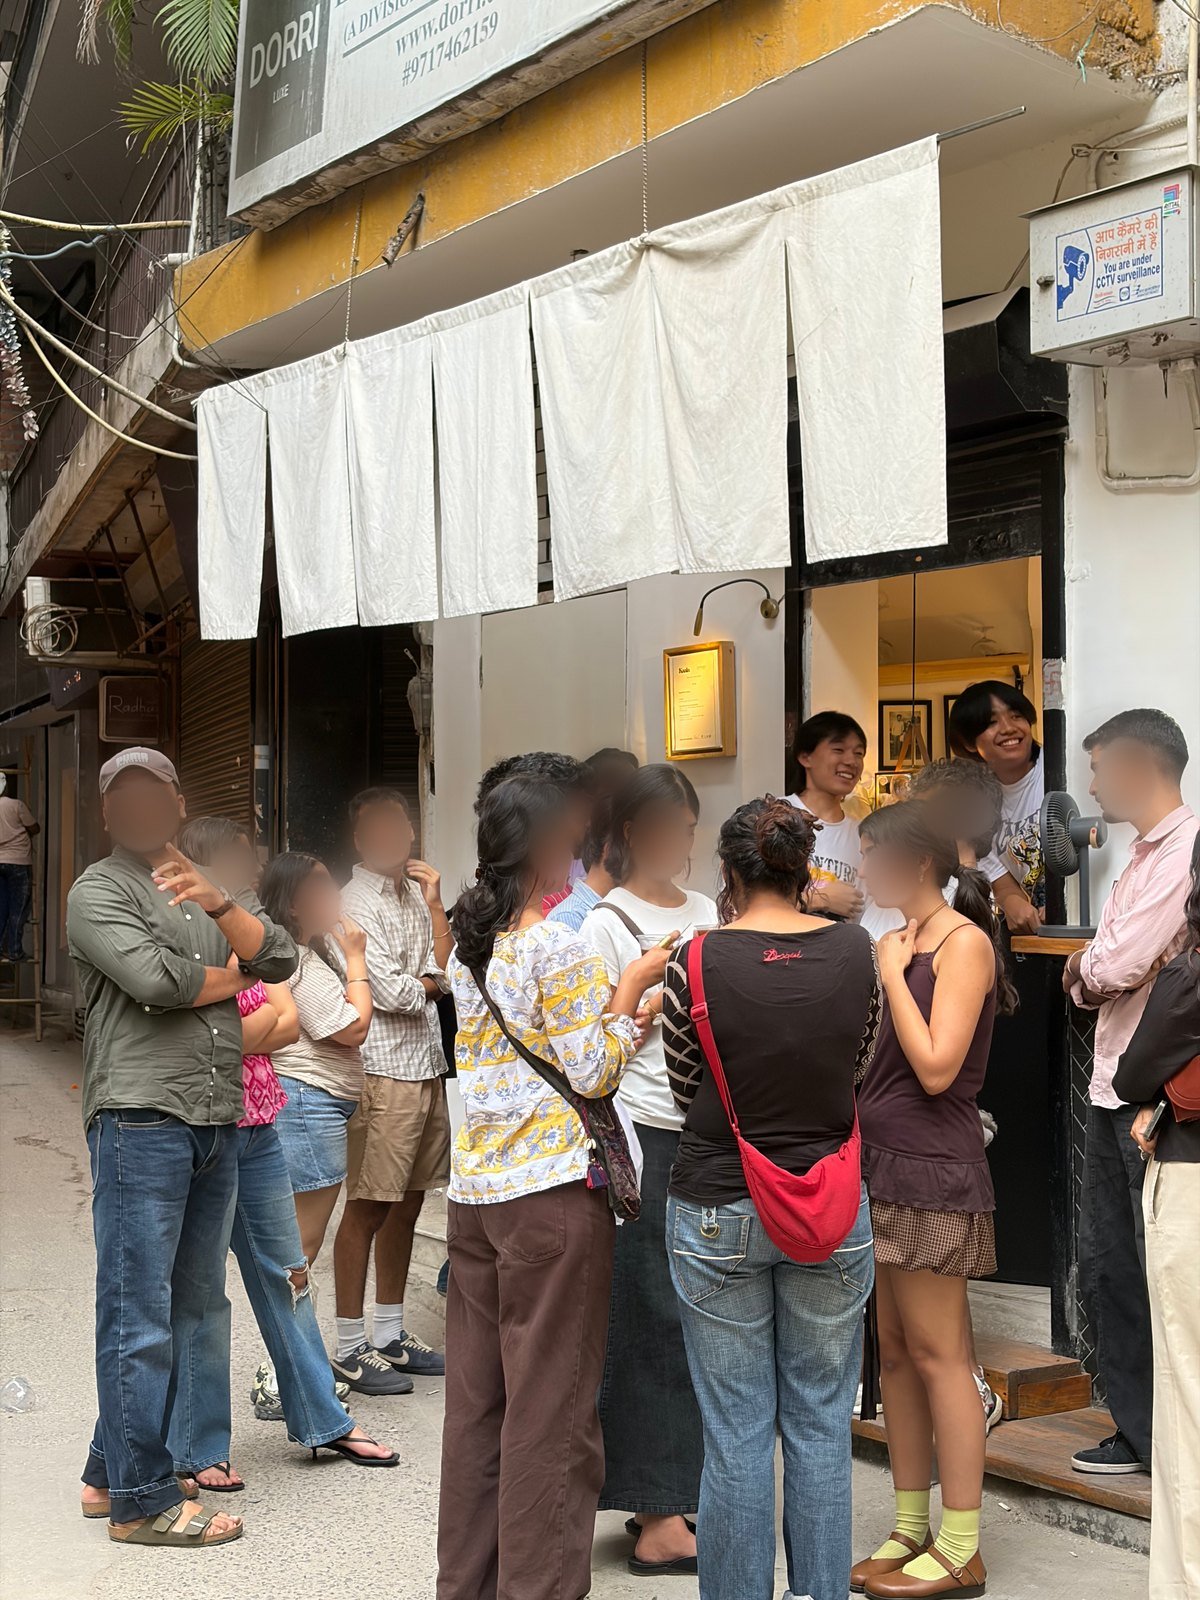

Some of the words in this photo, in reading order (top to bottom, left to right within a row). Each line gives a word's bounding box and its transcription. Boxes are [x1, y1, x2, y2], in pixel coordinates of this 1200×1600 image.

[343, 21, 356, 46] (A
[360, 0, 413, 33] DIVISI
[250, 4, 320, 88] DORRI
[402, 11, 498, 87] #9717462159
[1095, 228, 1115, 244] आप
[1117, 217, 1141, 238] कैमरे
[1145, 213, 1158, 230] की
[1095, 238, 1134, 262] निगरानी
[1137, 234, 1146, 250] में
[1104, 263, 1116, 274] You
[1118, 260, 1130, 270] are
[1132, 253, 1152, 266] under
[1096, 273, 1116, 289] CCTV
[1117, 264, 1161, 283] surveillance
